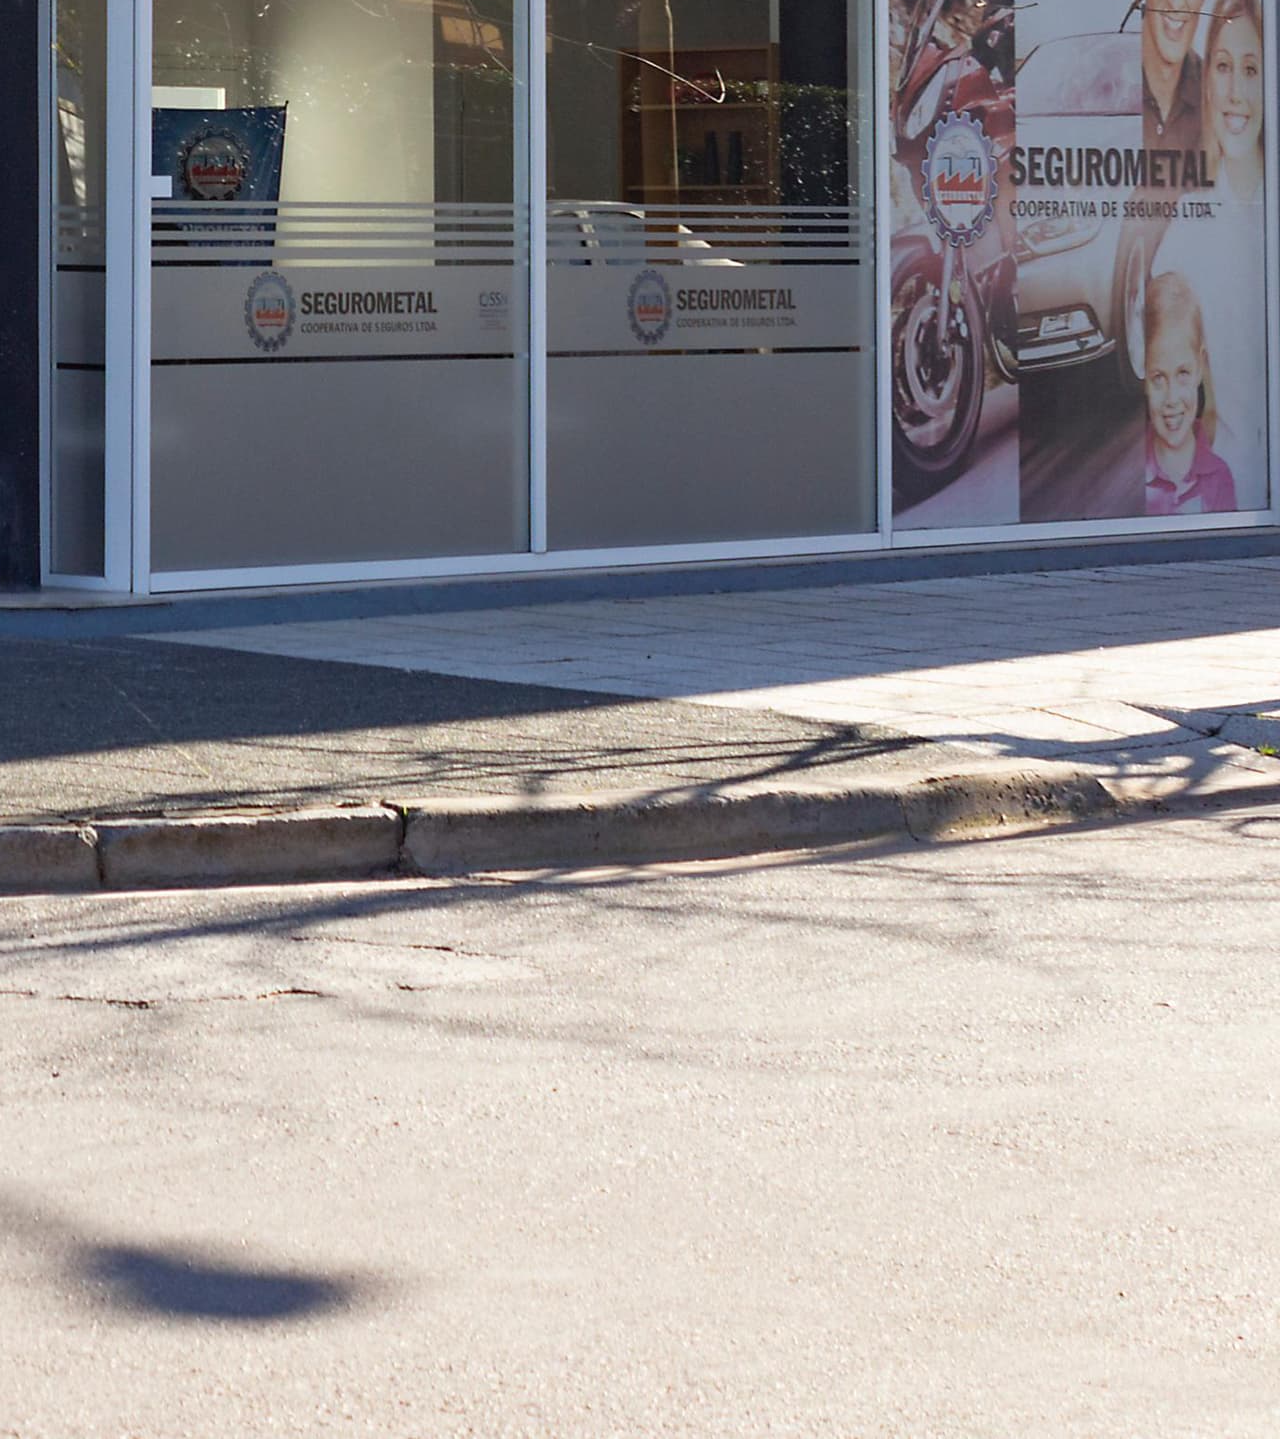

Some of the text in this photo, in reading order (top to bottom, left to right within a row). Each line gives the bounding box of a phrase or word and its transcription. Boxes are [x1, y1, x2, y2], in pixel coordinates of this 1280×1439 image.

[1009, 147, 1215, 188] SEGUROMETAL
[1009, 201, 1097, 218] COOPERATIVA
[1101, 201, 1117, 217] DE
[1122, 200, 1178, 218] SEGUROS
[301, 291, 438, 314] SEGUROMETAL
[676, 288, 796, 310] SEGUROMETAL
[300, 322, 358, 334] COOPERATIVA
[362, 322, 372, 333] DE
[375, 321, 413, 333] SEGUROS
